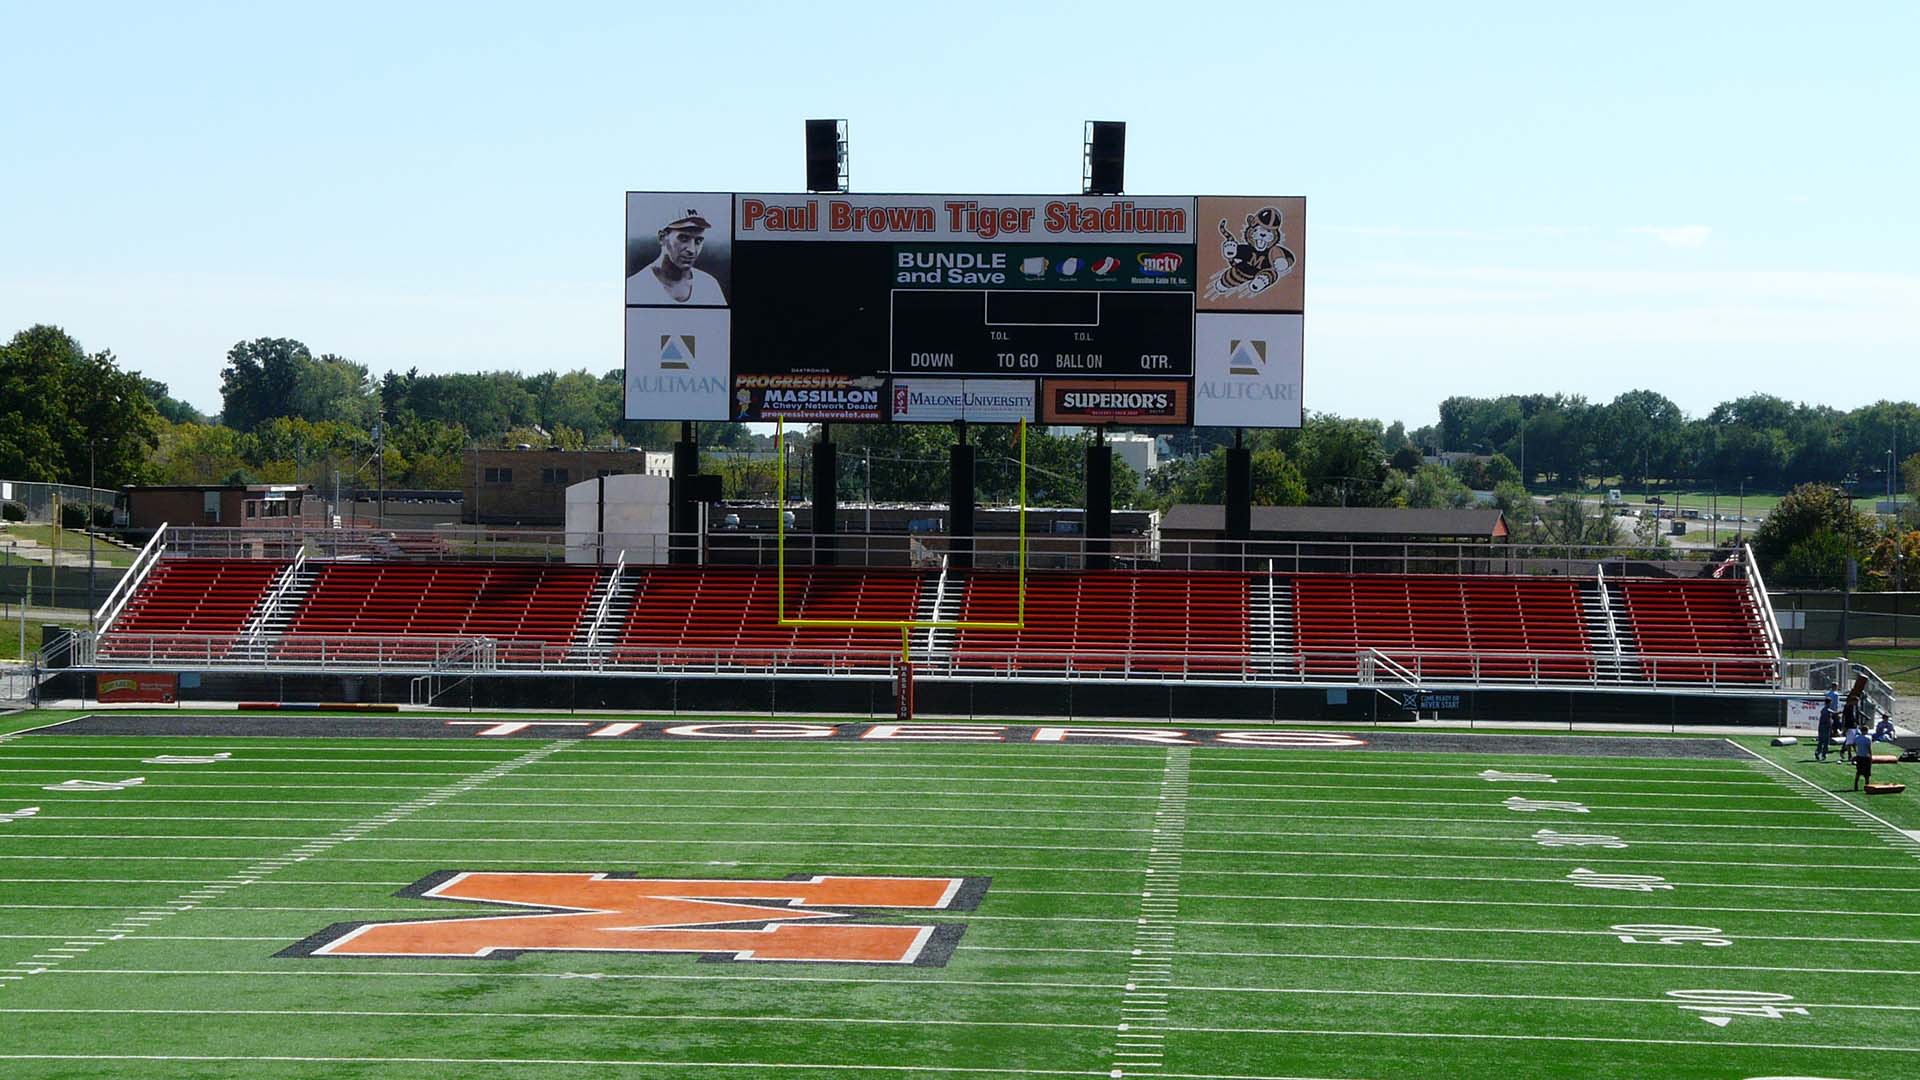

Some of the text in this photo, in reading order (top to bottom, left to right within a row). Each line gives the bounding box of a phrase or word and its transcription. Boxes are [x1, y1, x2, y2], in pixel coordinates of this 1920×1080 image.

[742, 200, 1187, 239] Paul Brown Tiger Stadium
[898, 252, 1006, 268] BUNDLE
[1143, 256, 1179, 272] mctv
[1247, 252, 1265, 269] M
[896, 268, 1006, 284] and Save
[910, 353, 954, 367] DOWN
[997, 353, 1039, 368] TO GO
[1056, 354, 1103, 369] BALL ON
[1140, 355, 1173, 369] QTR.
[629, 375, 728, 393] AULTMAN
[735, 375, 850, 389] PROGRESSIVE
[764, 390, 878, 402] MASSILLON
[1197, 382, 1297, 400] AULTCARE
[774, 402, 802, 410] Chevy
[805, 402, 845, 410] Network
[847, 402, 878, 410] Dealer
[909, 392, 1033, 407] MALONE UNIVERSITY
[1063, 393, 1168, 409] SUPERIOR'S
[900, 665, 908, 718] MASSILLON
[445, 719, 1368, 747] TIGERS
[285, 870, 983, 967] M
[1610, 923, 1733, 947] 50
[1665, 989, 1810, 1019] 40
